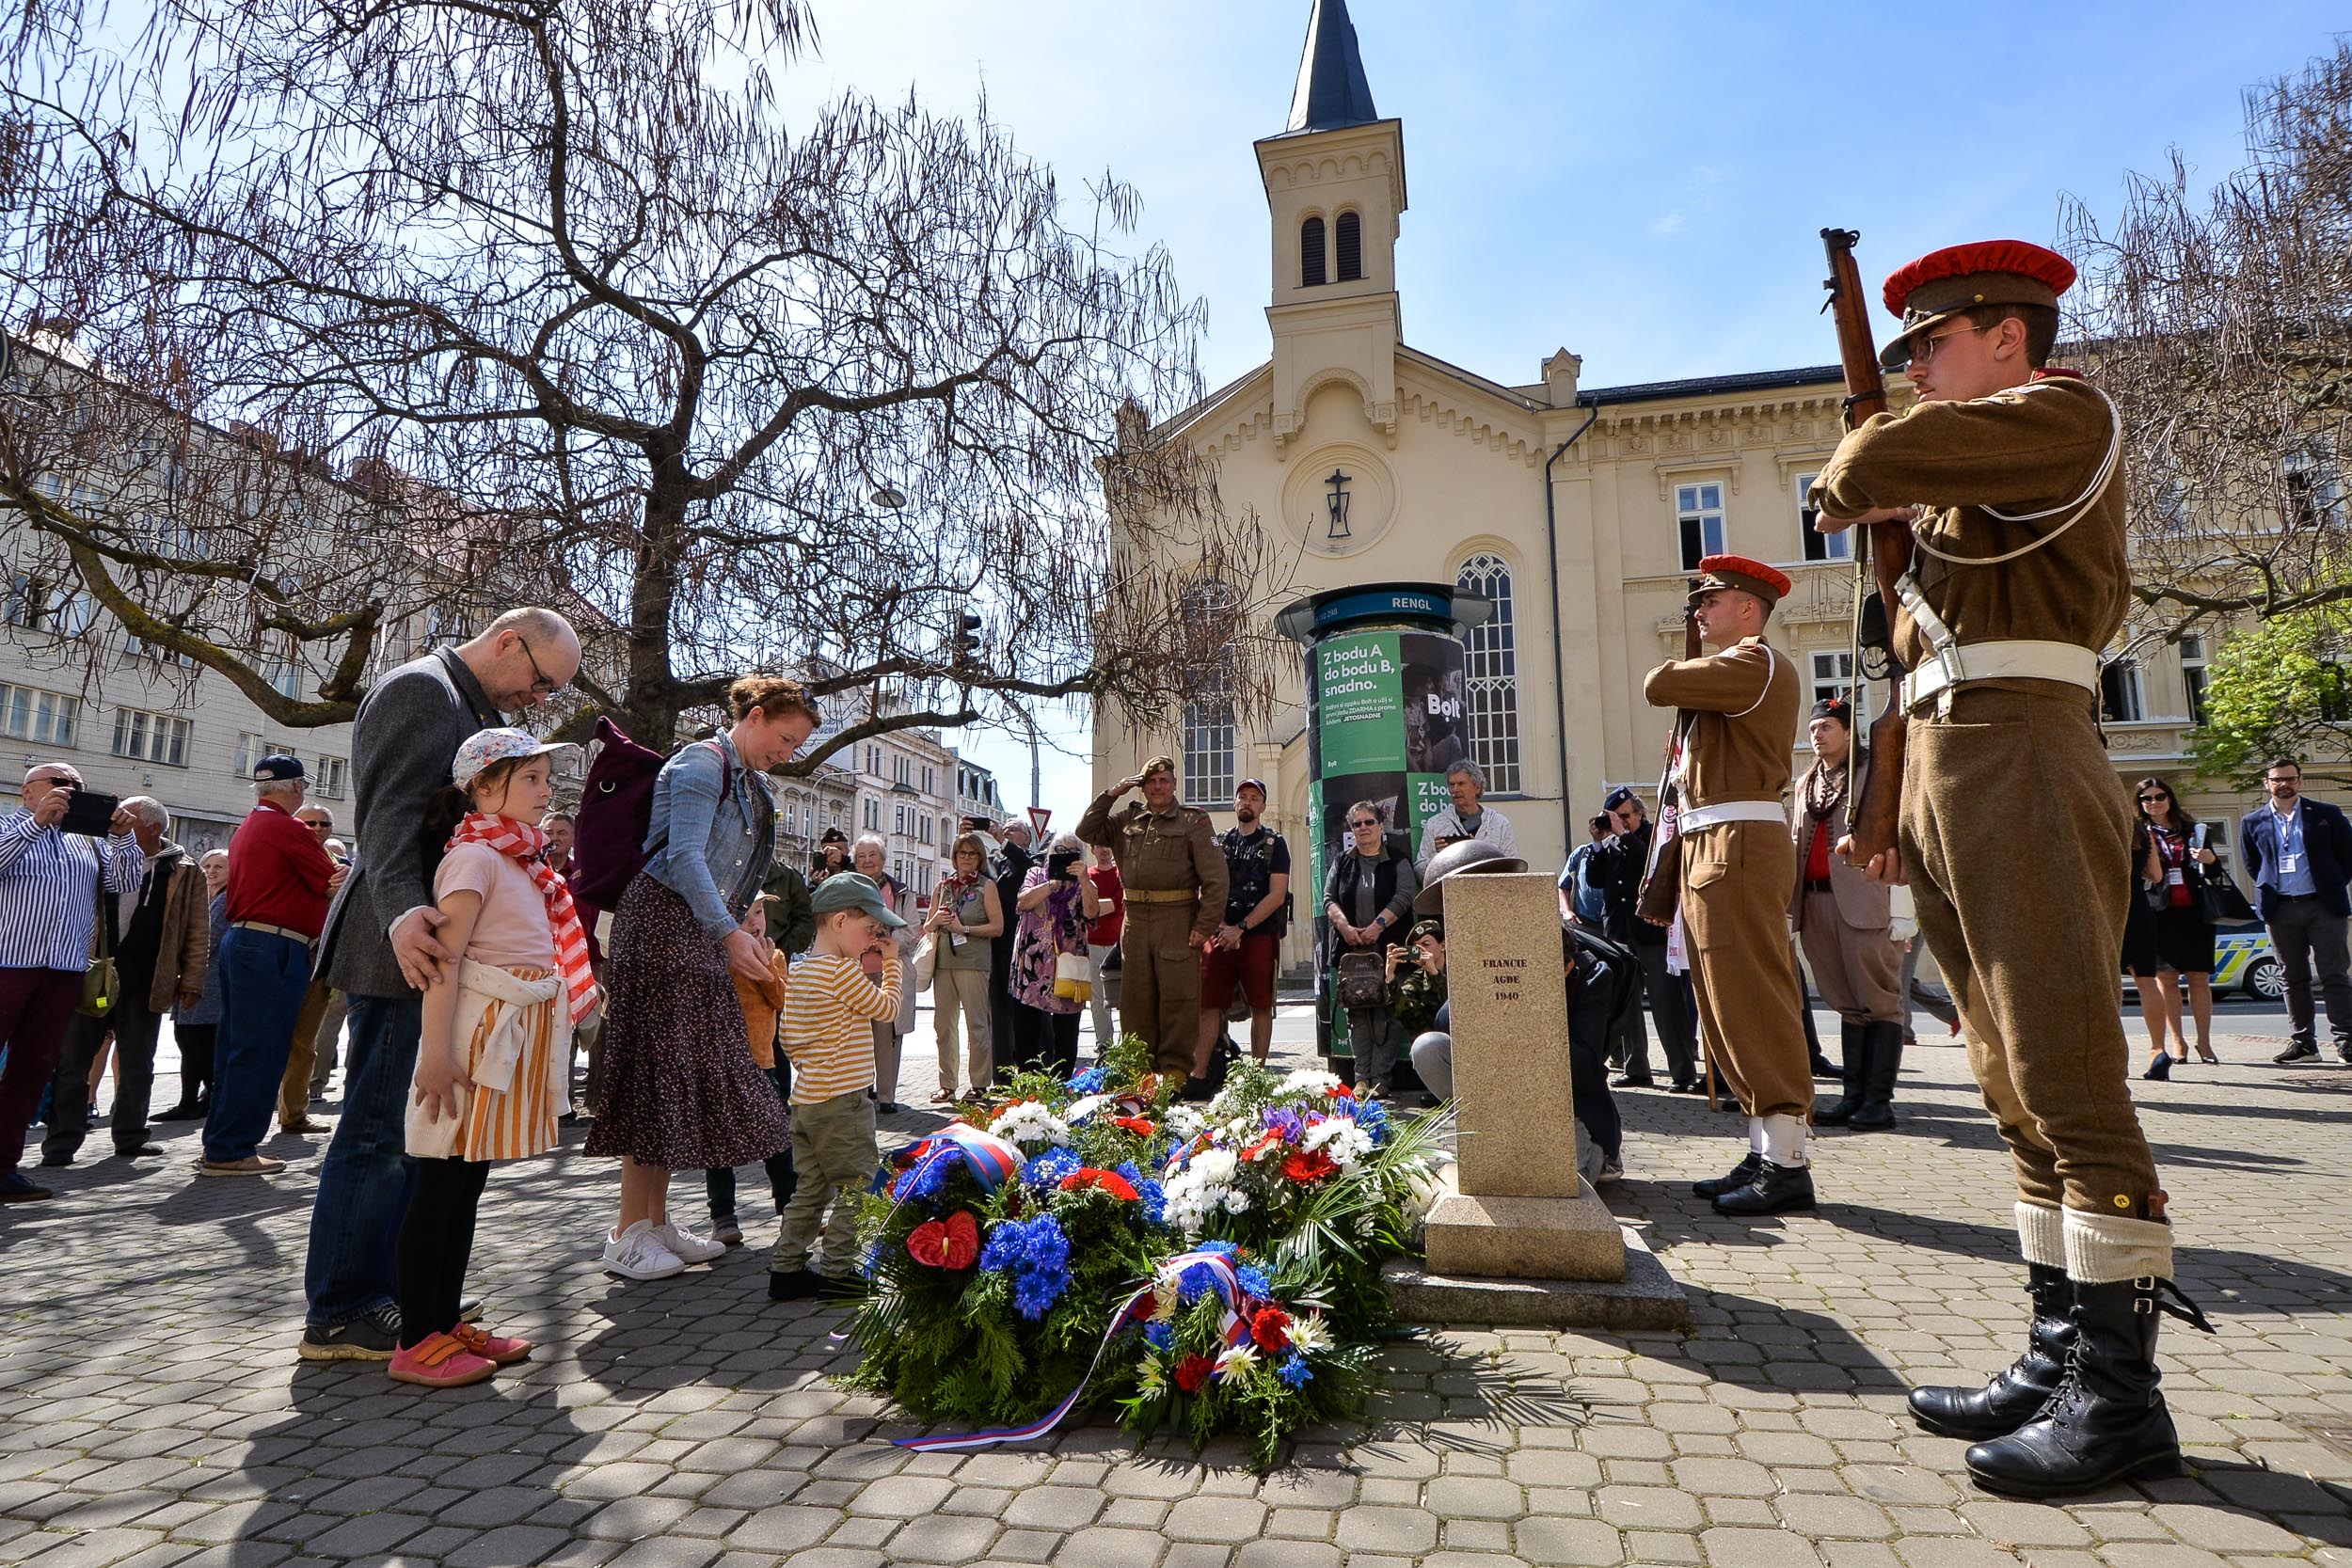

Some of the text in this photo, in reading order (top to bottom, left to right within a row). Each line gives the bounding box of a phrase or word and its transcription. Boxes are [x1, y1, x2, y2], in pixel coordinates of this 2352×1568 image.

[1392, 597, 1432, 610] RENGL
[1324, 643, 1383, 666] Z bodu A
[1324, 659, 1395, 681] do bodu B,
[1325, 678, 1377, 697] snadno.
[1427, 693, 1461, 722] Bolt
[1418, 782, 1451, 796] Z bo
[1419, 799, 1438, 813] do
[1483, 958, 1528, 968] FRANCIE
[1493, 974, 1520, 984] AGDE
[1495, 991, 1519, 1001] 1940
